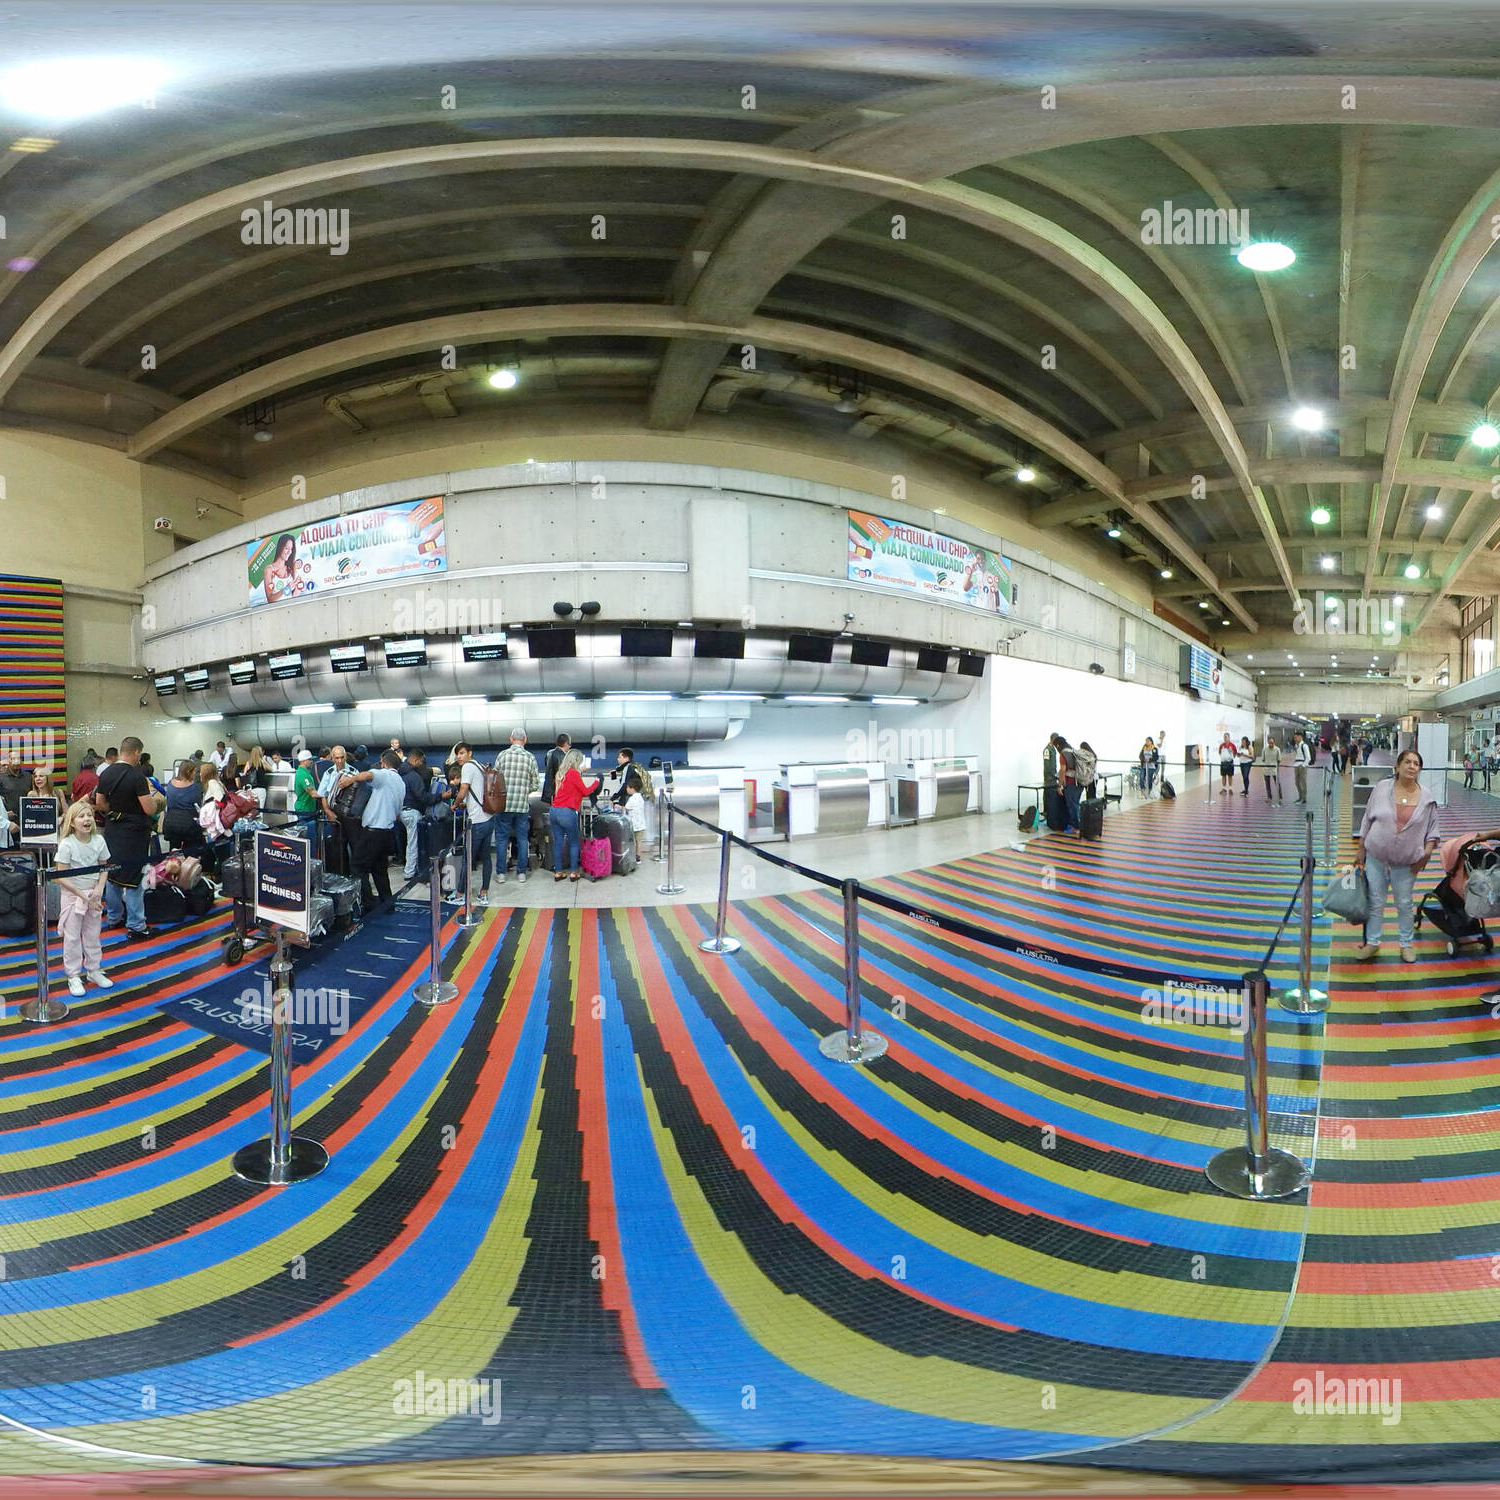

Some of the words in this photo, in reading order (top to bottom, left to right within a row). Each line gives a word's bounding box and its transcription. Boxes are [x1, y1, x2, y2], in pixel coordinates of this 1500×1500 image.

[300, 522, 342, 546] ALQUILA
[346, 517, 359, 533] TU
[362, 511, 389, 530] CHIP
[309, 545, 317, 559] Y
[318, 540, 346, 557] VIAJA
[348, 526, 421, 551] COMUNICADO
[893, 526, 933, 549] ALQUILA
[935, 537, 947, 552] TU
[949, 541, 968, 559] CHIP
[880, 541, 907, 558] VIAJA
[909, 545, 964, 574] COMUNICADO
[263, 848, 302, 862] PLUSULTRA
[261, 883, 302, 902] BUSINESS
[909, 911, 940, 927] PLUSULTRA
[1016, 947, 1059, 964] PLUSULTRA
[1167, 979, 1226, 992] PLUSULTRA
[180, 997, 324, 1051] PLUSULRA
